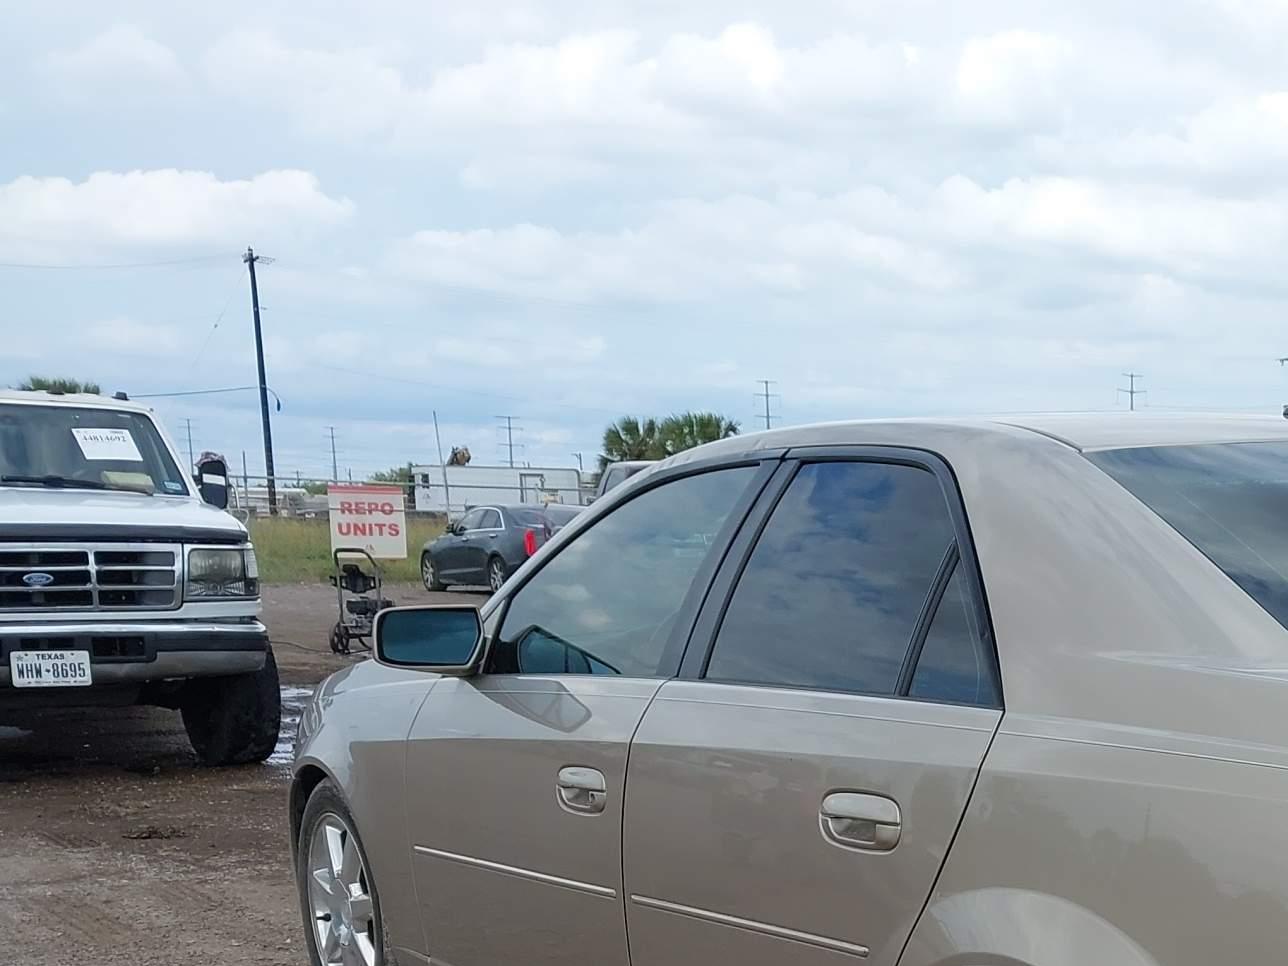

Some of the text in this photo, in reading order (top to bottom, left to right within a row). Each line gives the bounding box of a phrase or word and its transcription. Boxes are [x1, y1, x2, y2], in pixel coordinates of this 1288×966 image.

[339, 501, 395, 516] REPO
[337, 522, 400, 537] UNITS
[35, 653, 65, 661] TEXAS
